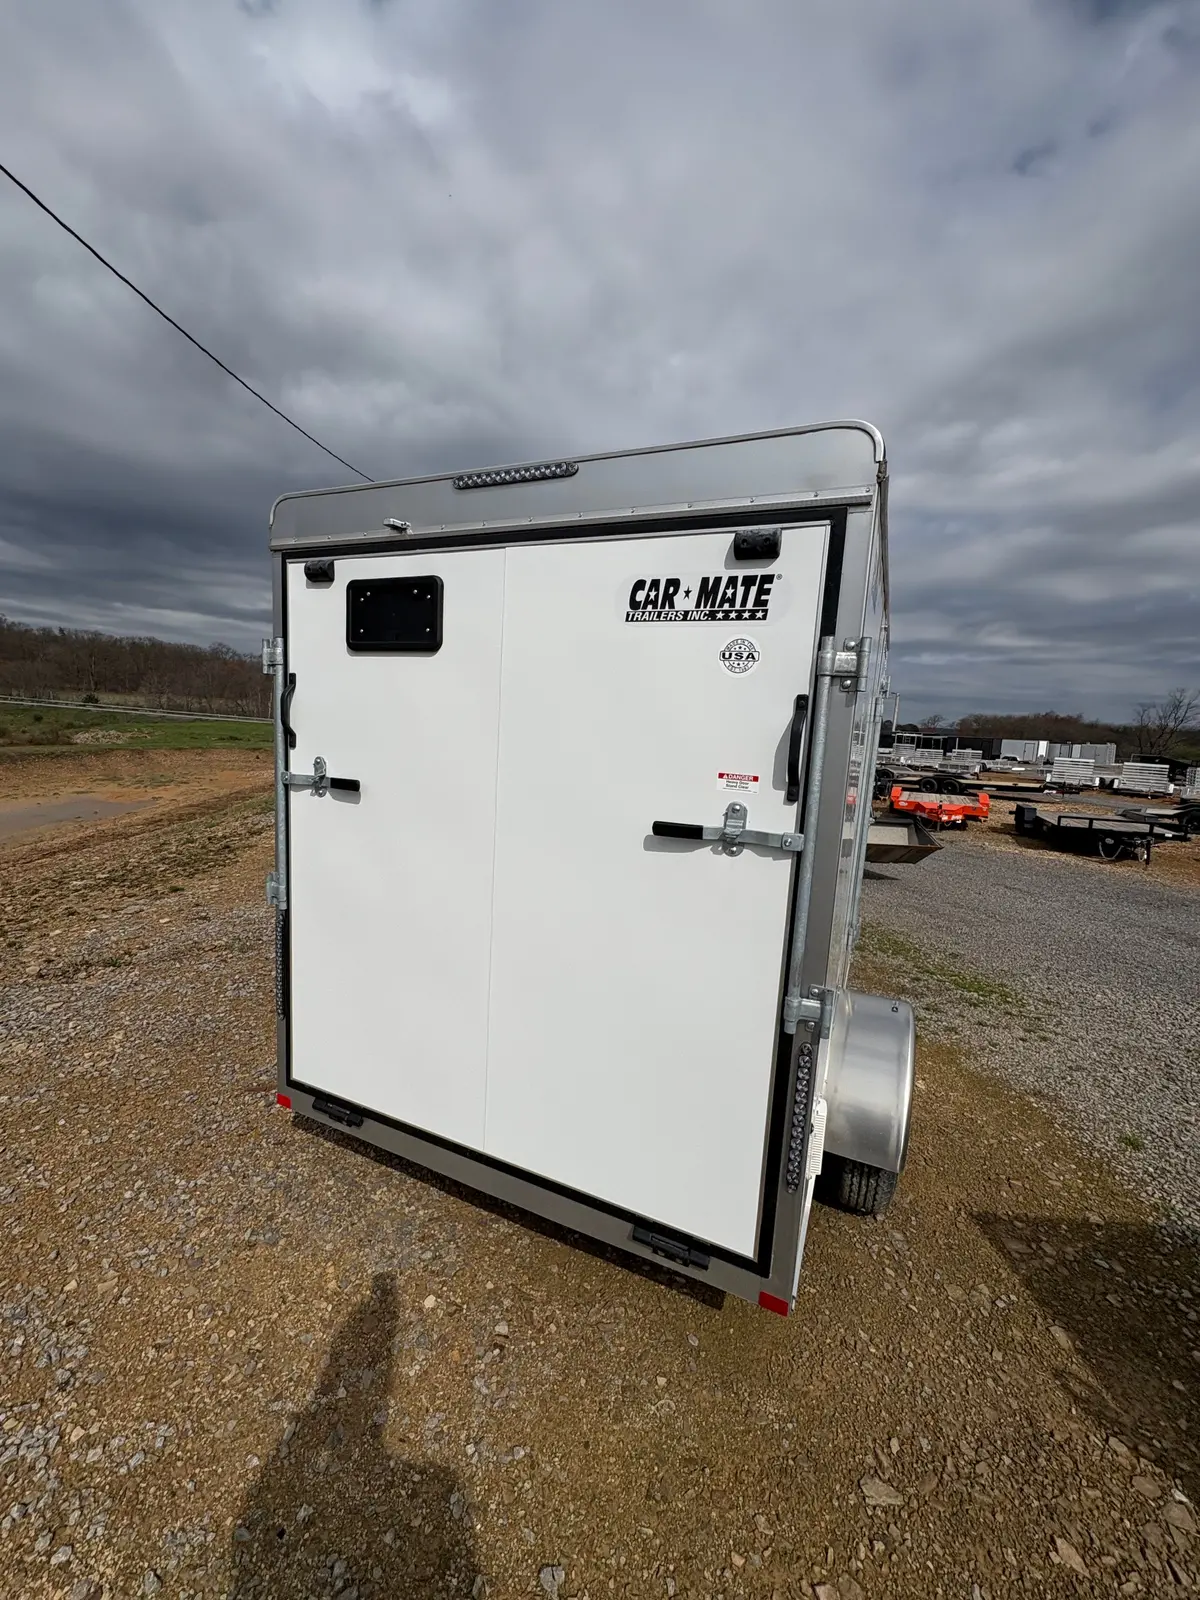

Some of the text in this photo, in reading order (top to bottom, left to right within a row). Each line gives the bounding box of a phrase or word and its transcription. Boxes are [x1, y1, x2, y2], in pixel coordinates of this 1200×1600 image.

[629, 578, 681, 611] CAR
[694, 574, 775, 609] MATE
[628, 610, 712, 621] TRAILERS INC.
[722, 652, 756, 660] USA
